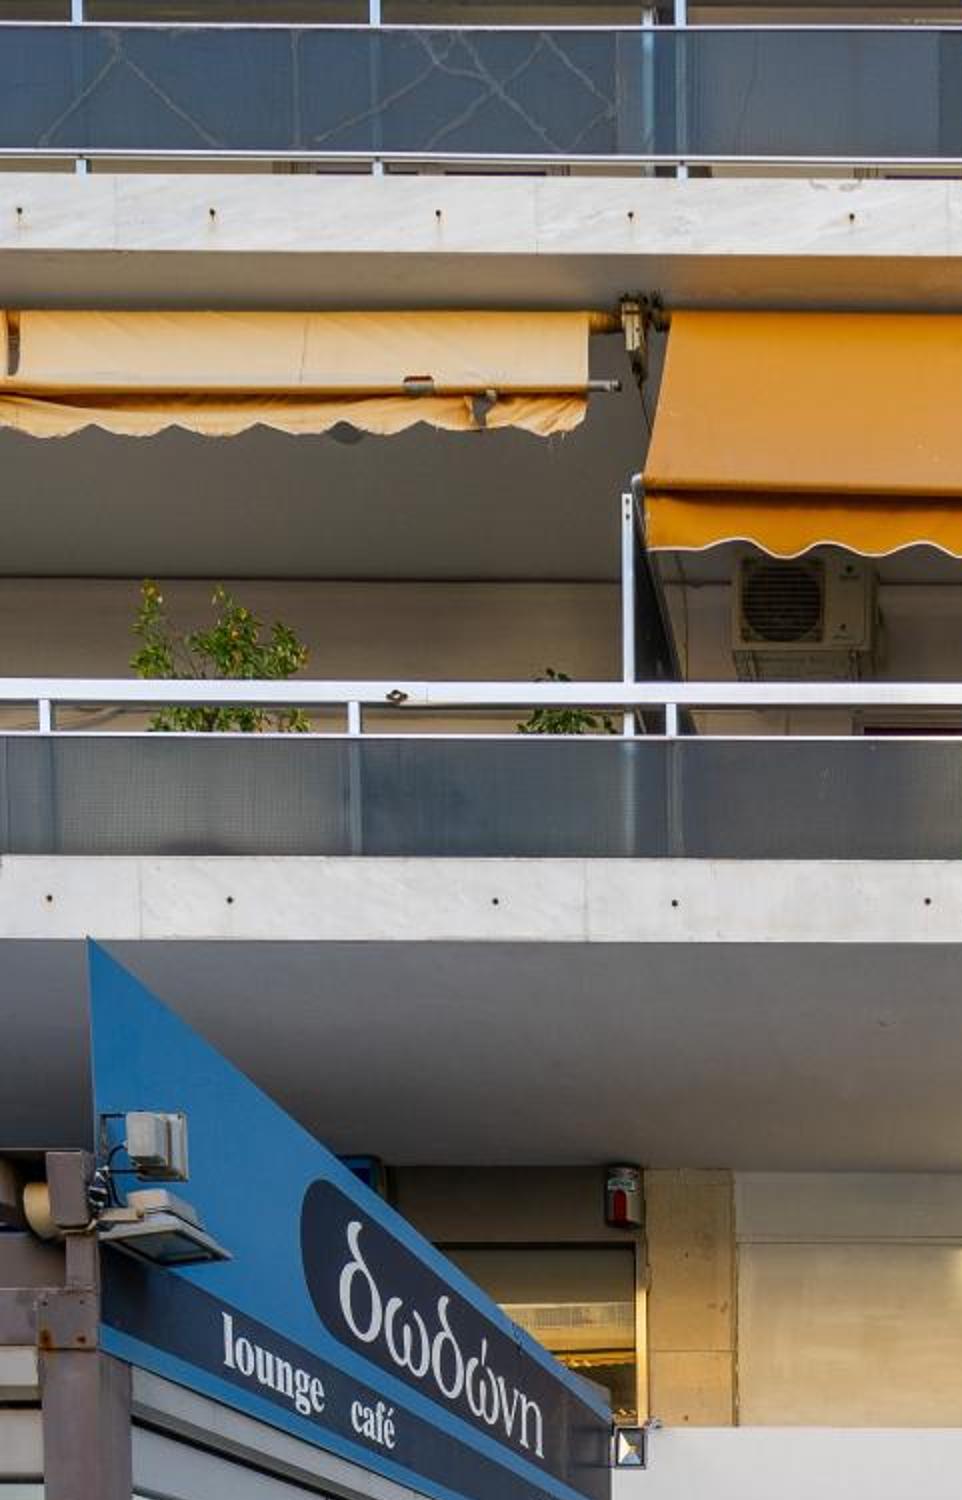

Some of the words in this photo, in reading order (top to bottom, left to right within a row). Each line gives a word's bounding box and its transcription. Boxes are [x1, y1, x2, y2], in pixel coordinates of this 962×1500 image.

[222, 1311, 326, 1415] lounge
[351, 1399, 396, 1451] café
[338, 1221, 545, 1460] δωδώνη
